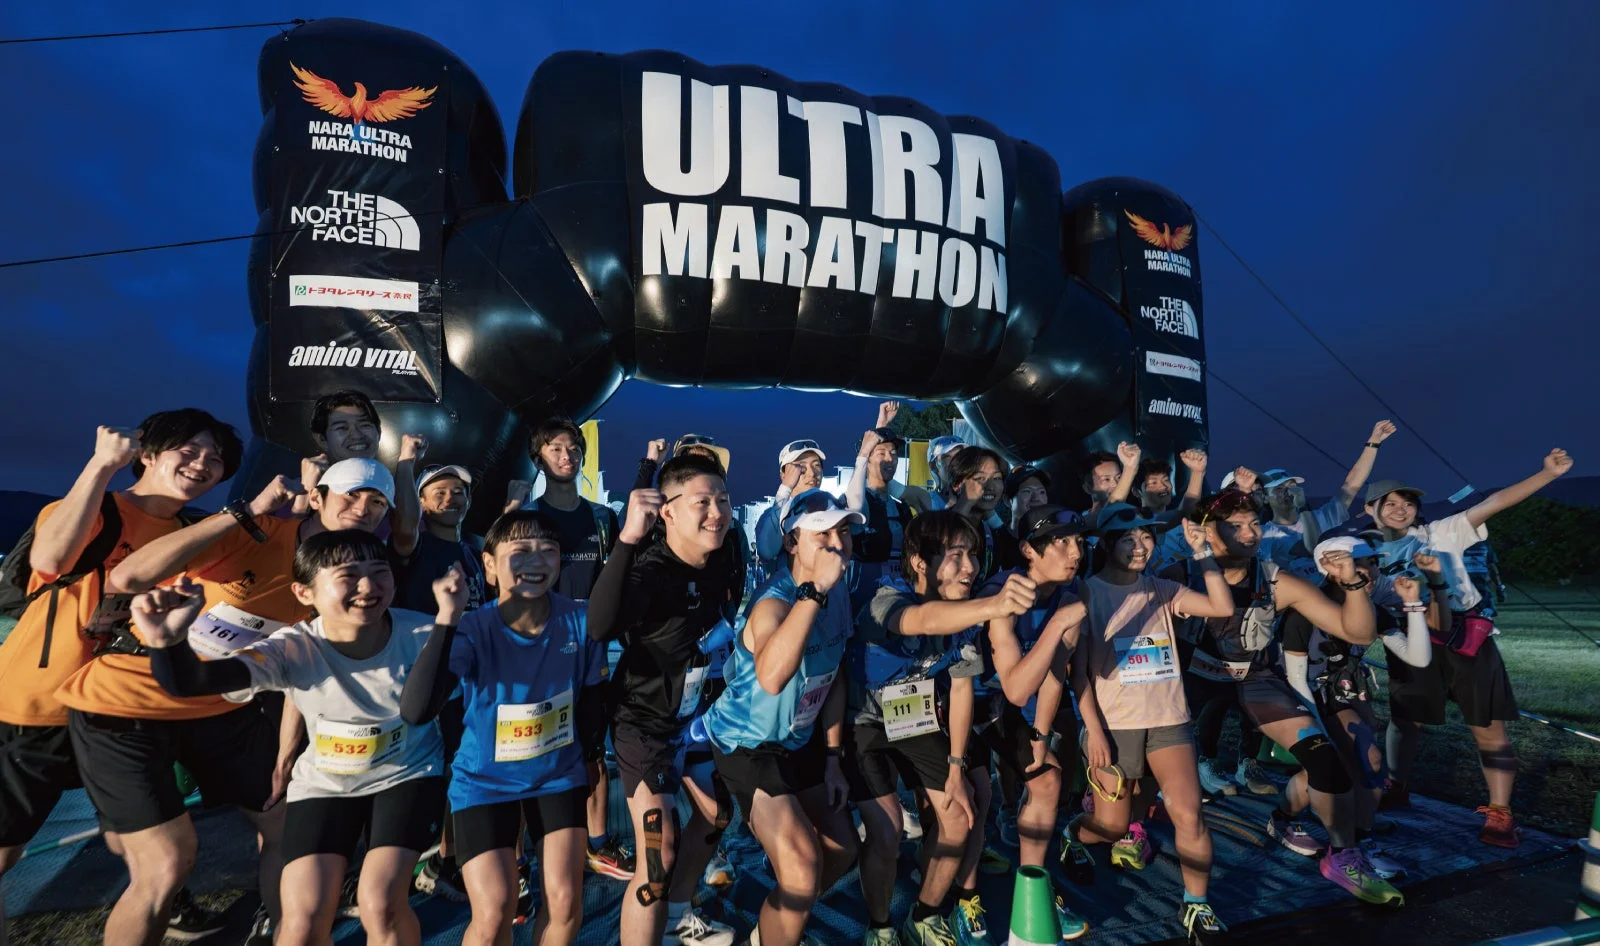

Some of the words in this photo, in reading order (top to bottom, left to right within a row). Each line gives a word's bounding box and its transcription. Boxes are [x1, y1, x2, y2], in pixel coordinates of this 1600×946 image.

[309, 120, 355, 137] NARA
[359, 125, 413, 149] ULTRA
[311, 136, 408, 163] MARATHON
[642, 71, 1006, 249] ULTRA
[327, 189, 375, 212] THE
[290, 205, 375, 229] NORTH
[312, 223, 374, 246] FACE
[642, 202, 1008, 315] MARATHON
[1144, 249, 1170, 261] NARA
[1170, 252, 1192, 269] ULTRA
[1147, 260, 1192, 279] MARATHON
[1159, 296, 1182, 311] THE
[1140, 305, 1183, 323] NORTH
[1154, 319, 1184, 335] FACE
[288, 340, 363, 367] amino
[363, 347, 417, 371] VITAL
[1148, 397, 1182, 417] amino
[209, 625, 241, 643] 161
[1127, 653, 1150, 665] 501
[893, 702, 911, 717] 111
[924, 699, 931, 710] B
[513, 723, 543, 738] 533
[333, 743, 368, 755] 532
